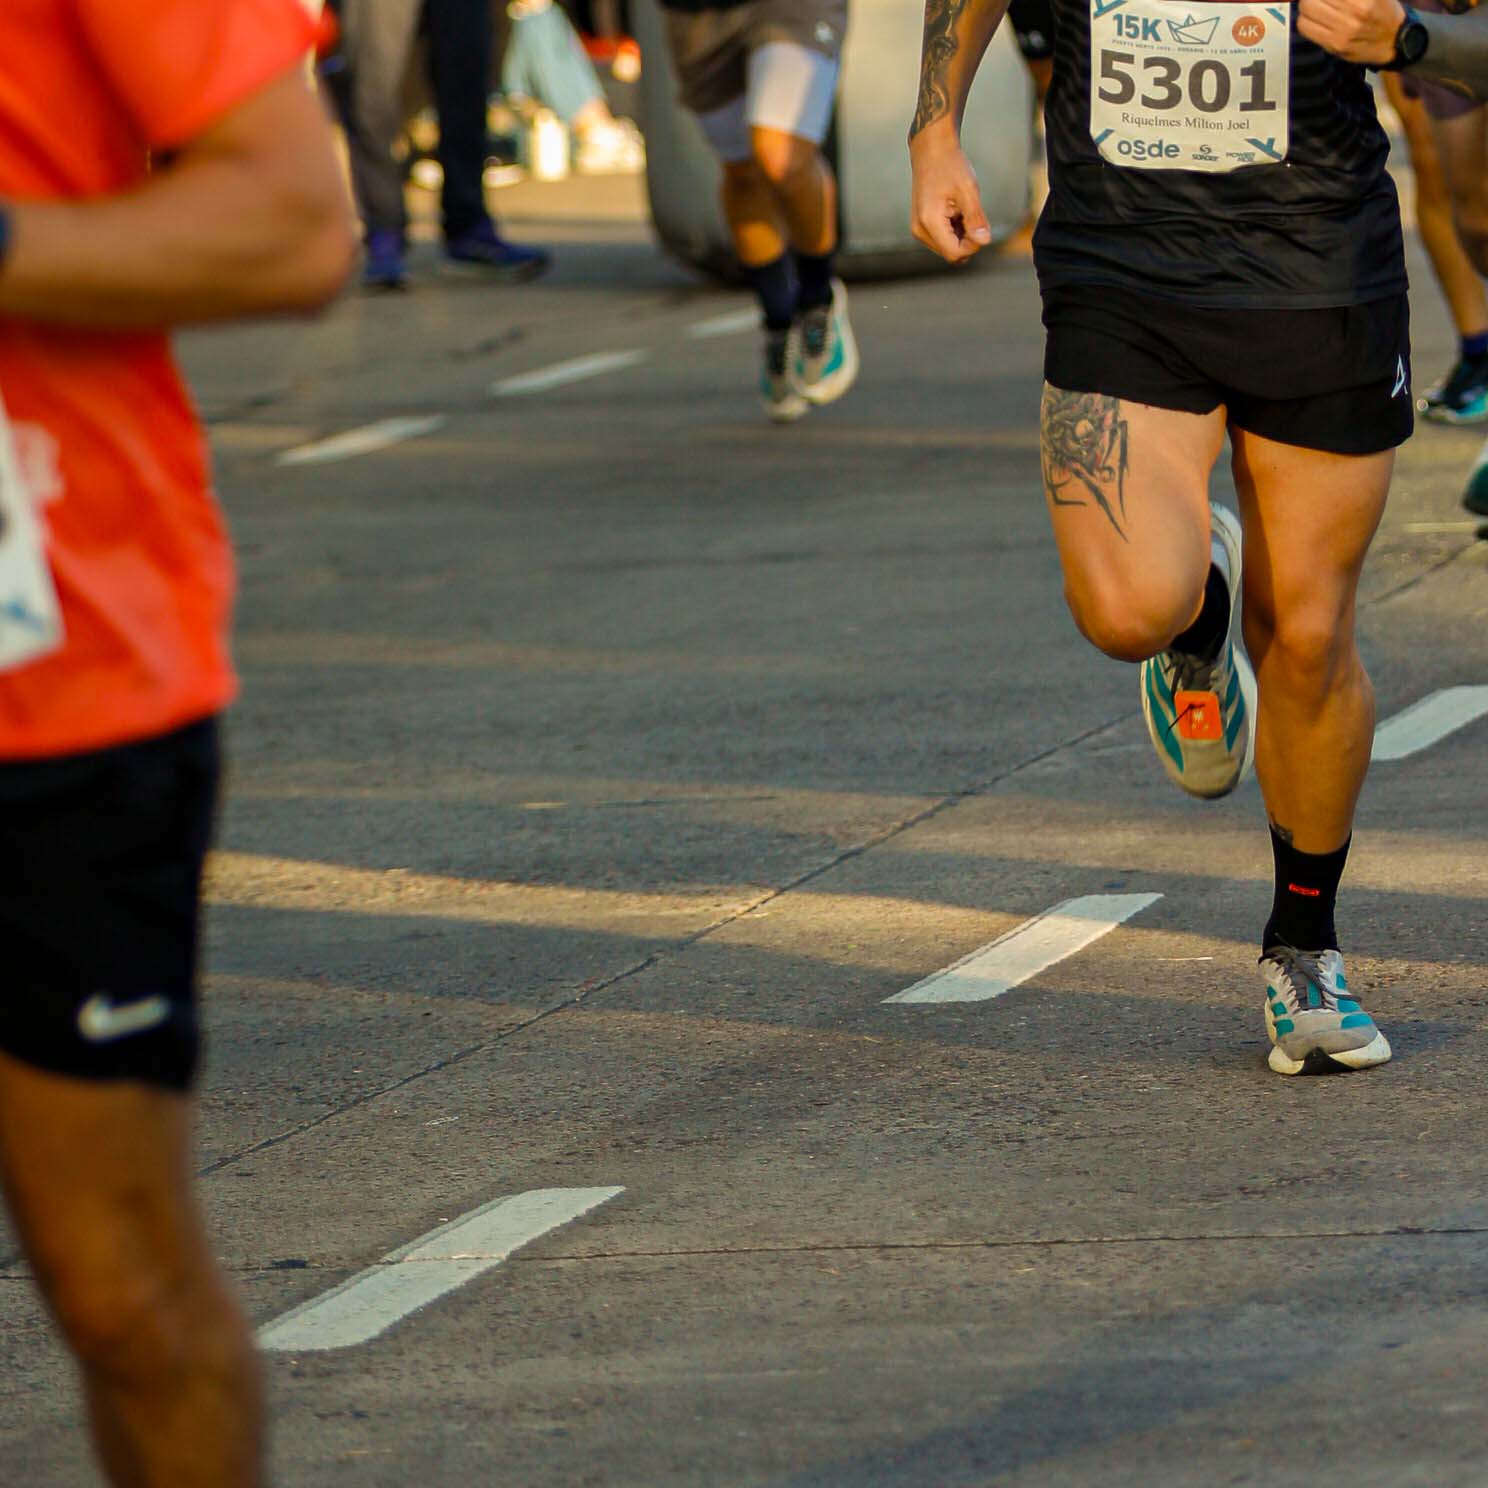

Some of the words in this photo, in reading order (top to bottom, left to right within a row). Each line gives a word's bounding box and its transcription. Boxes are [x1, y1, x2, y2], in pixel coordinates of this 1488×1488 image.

[1112, 13, 1162, 42] 15K
[1238, 24, 1259, 38] 4K
[1098, 49, 1276, 113] 5301
[1121, 112, 1182, 128] Riquelmes
[1185, 116, 1223, 130] Milton
[1227, 119, 1250, 130] Joel
[1117, 139, 1180, 161] osde
